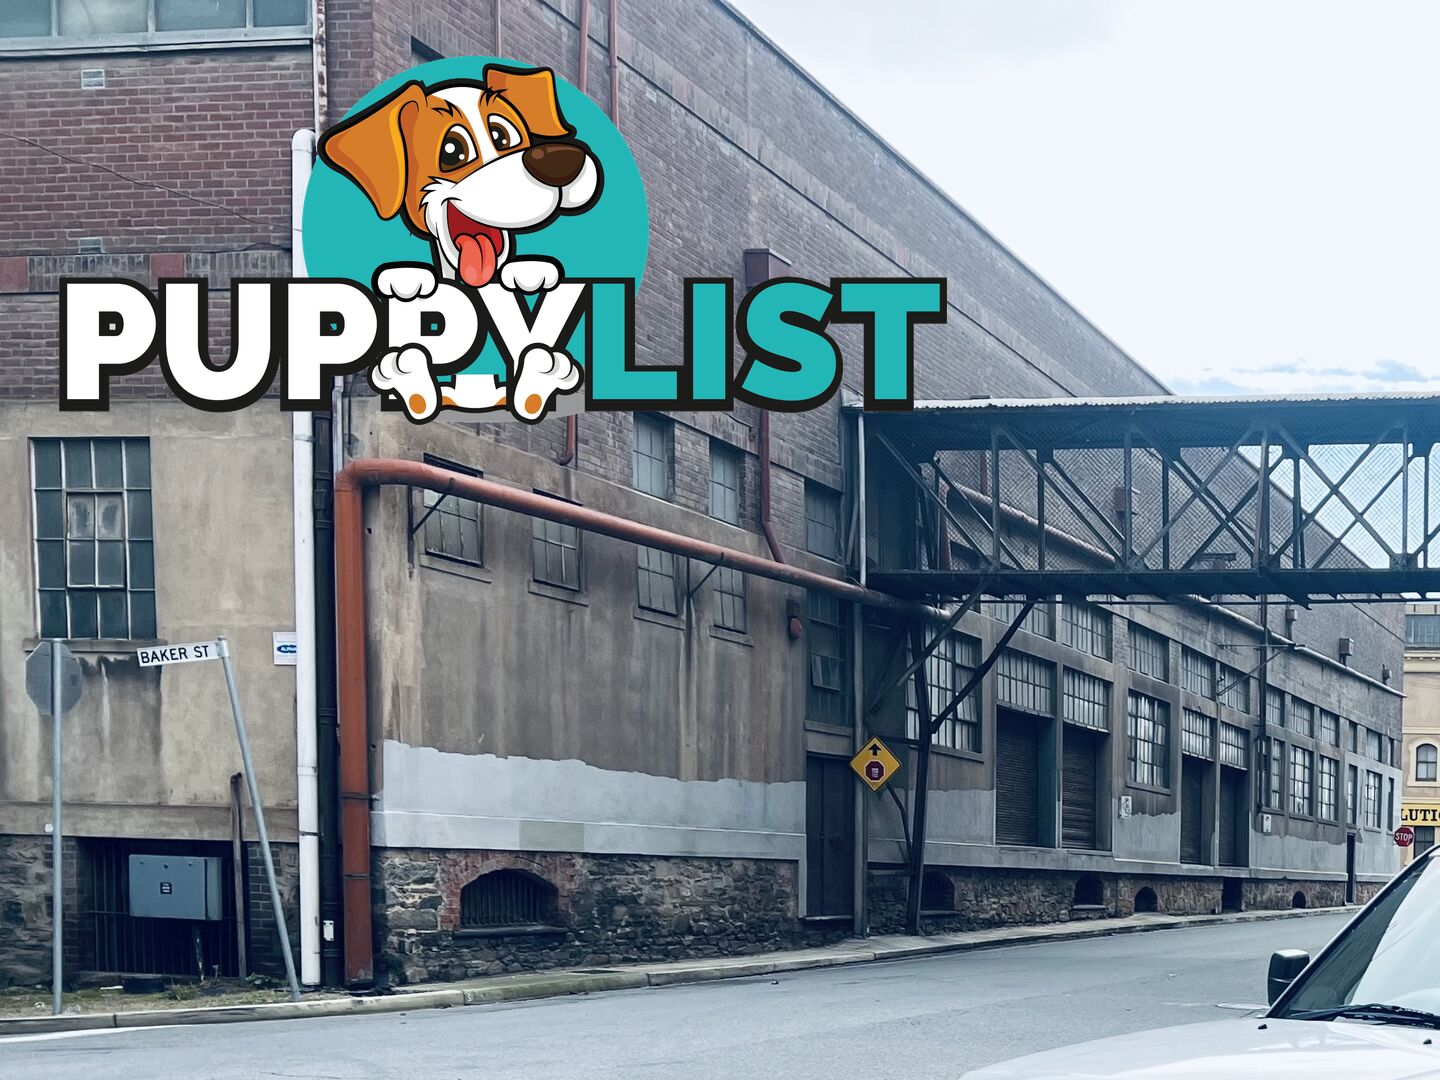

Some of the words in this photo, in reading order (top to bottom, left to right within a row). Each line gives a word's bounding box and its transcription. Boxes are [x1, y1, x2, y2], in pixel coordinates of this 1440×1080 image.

[140, 648, 188, 664] BAKER
[194, 645, 209, 658] ST
[1395, 832, 1413, 842] STOP
